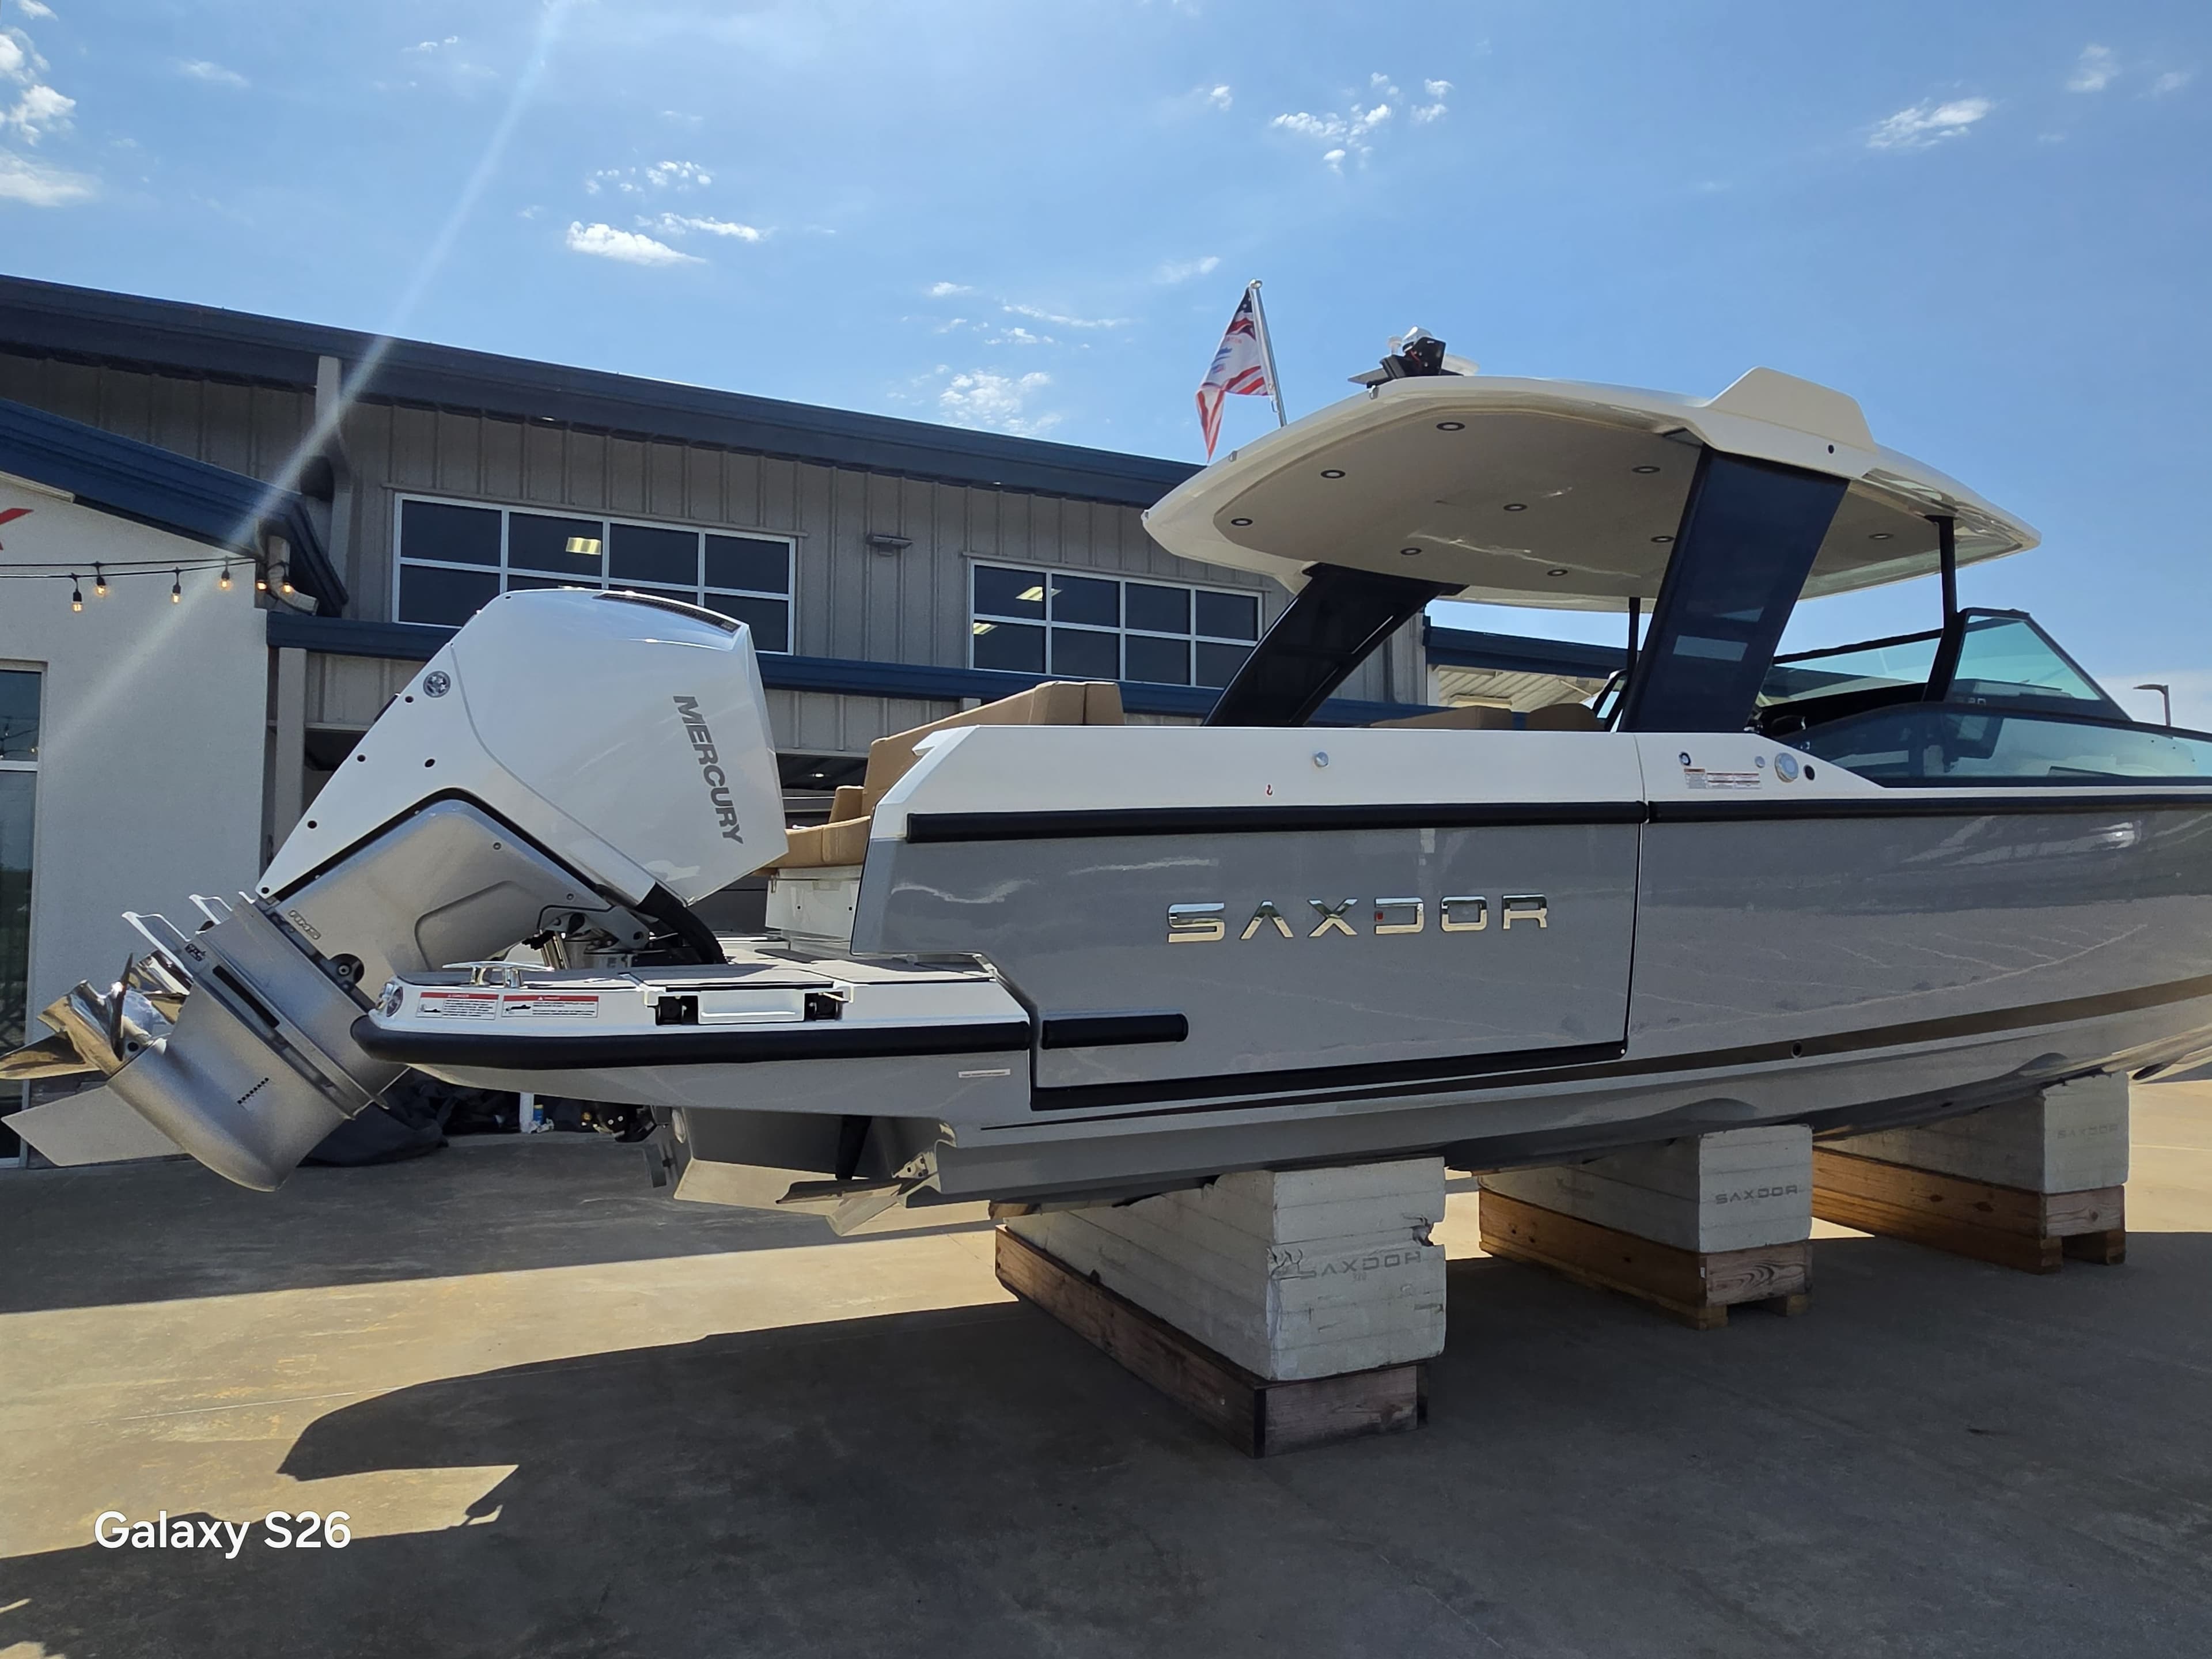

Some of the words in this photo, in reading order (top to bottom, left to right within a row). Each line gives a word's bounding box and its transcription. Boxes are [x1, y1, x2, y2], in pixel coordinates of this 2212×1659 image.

[673, 695, 744, 844] MERCURY
[1168, 893, 1548, 943] SAXDOR
[1715, 1184, 1798, 1205] SAXDOR
